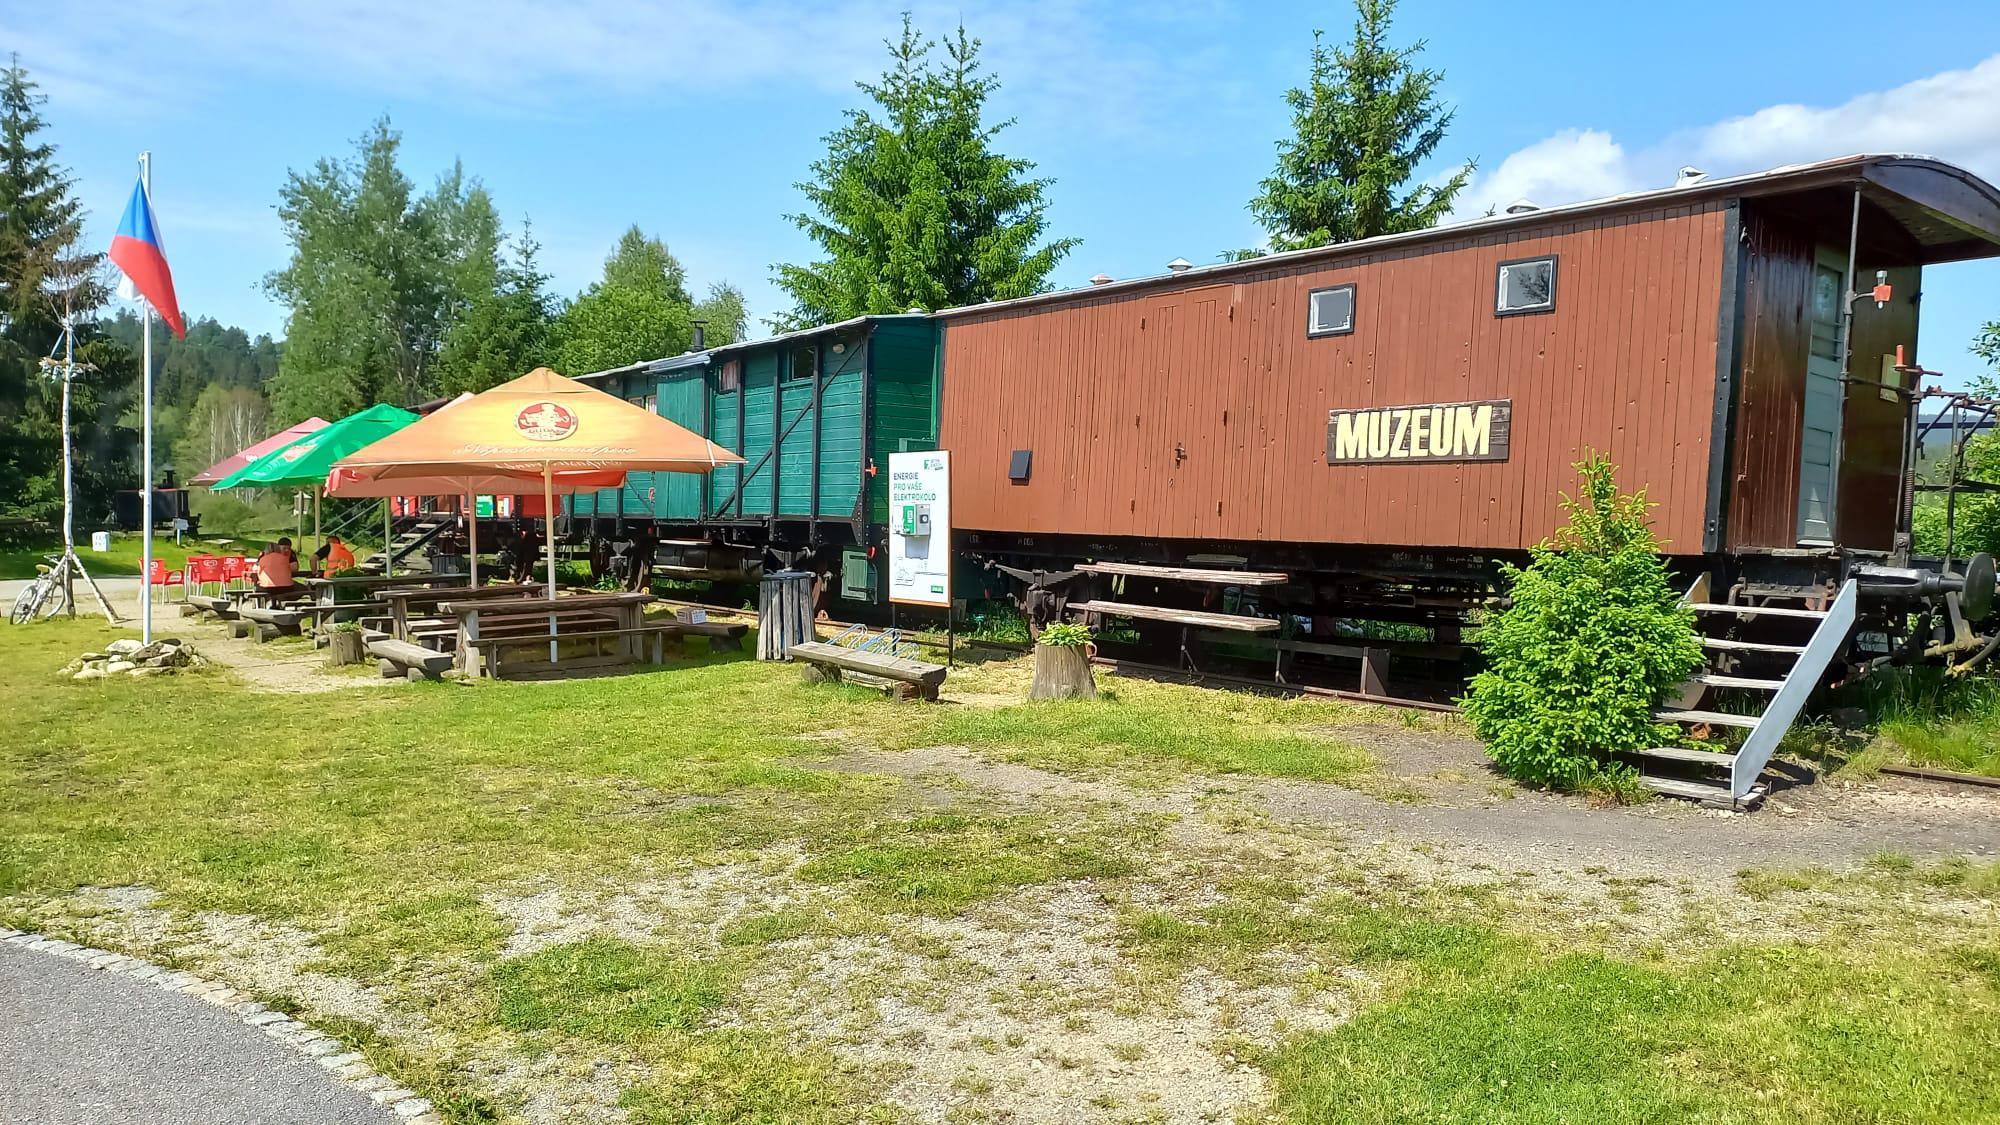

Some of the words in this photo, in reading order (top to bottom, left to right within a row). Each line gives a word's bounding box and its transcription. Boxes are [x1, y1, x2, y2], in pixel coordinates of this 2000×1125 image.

[1336, 405, 1493, 459] MUZEUM
[893, 472, 919, 480] ENERGIE
[893, 482, 906, 491] PRO
[907, 480, 922, 491] VAŠE
[893, 493, 936, 501] ELEKTROKOLO
